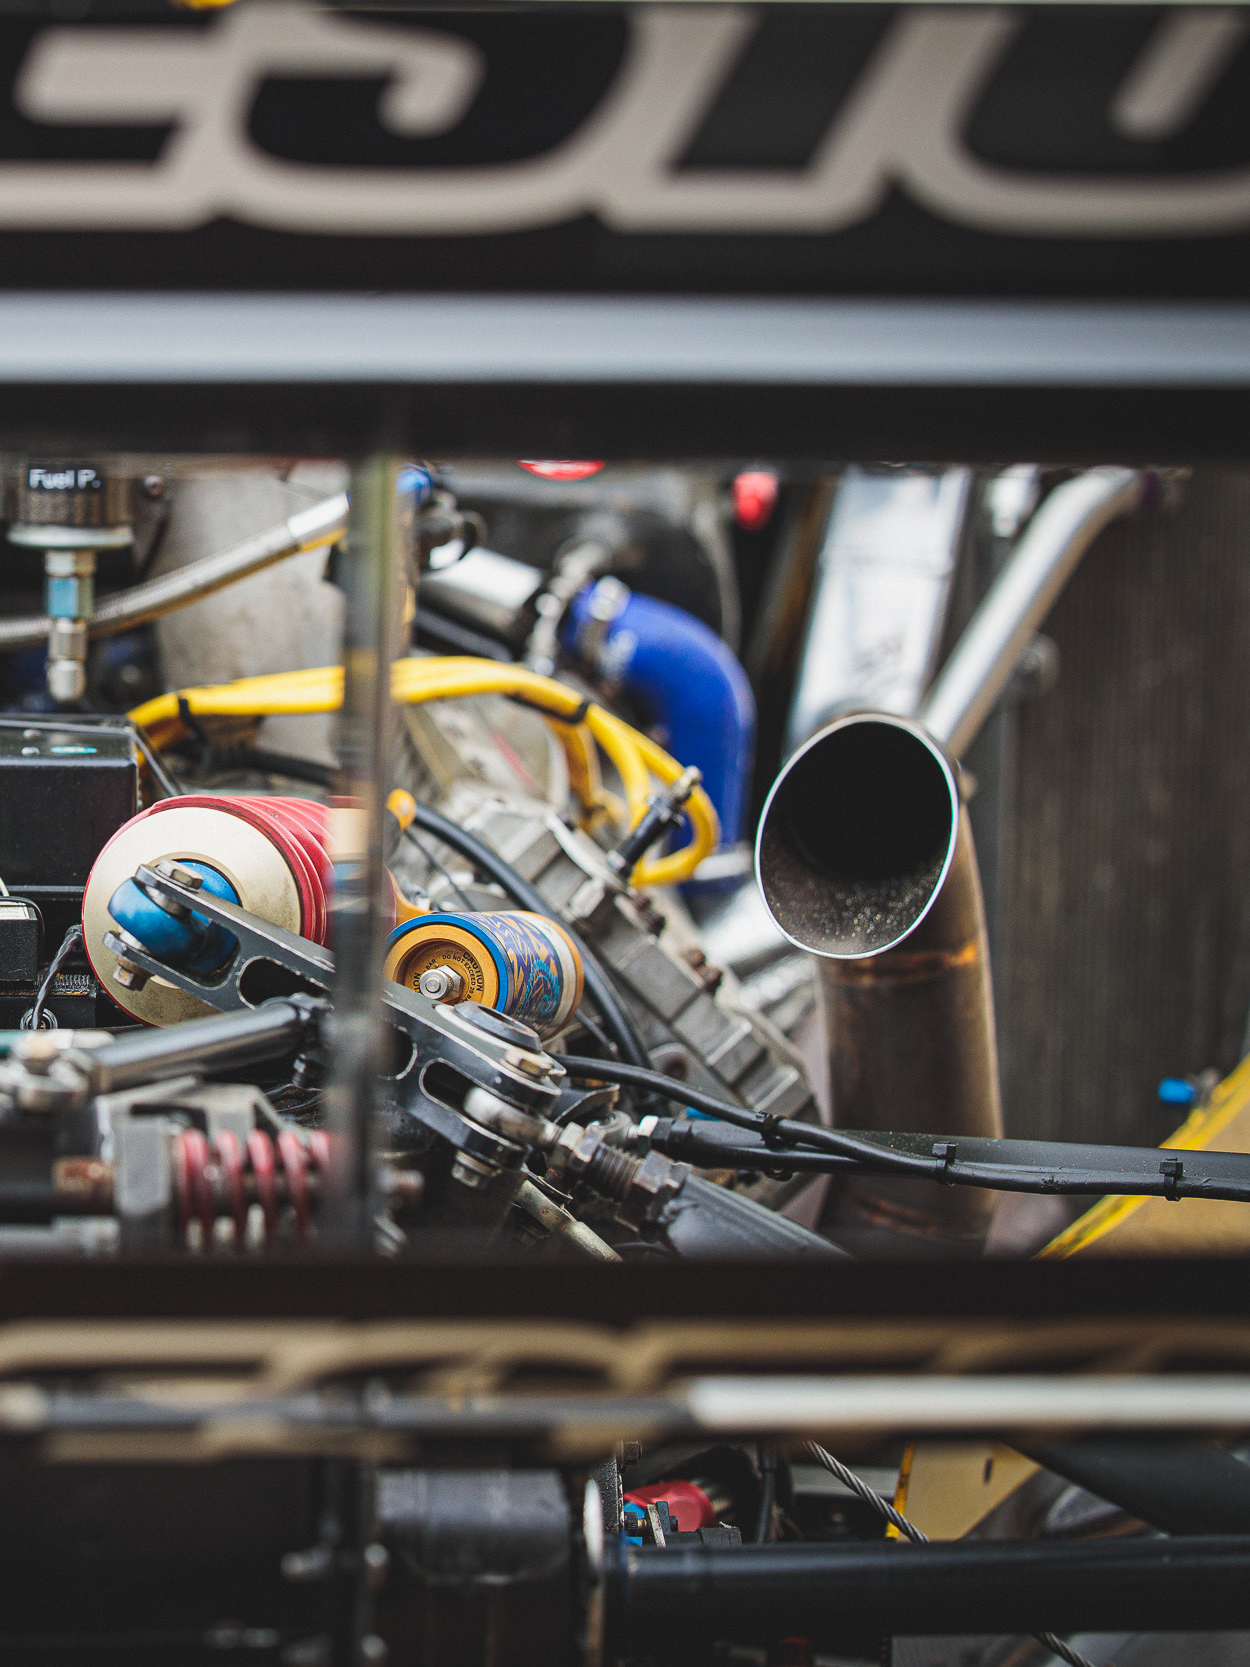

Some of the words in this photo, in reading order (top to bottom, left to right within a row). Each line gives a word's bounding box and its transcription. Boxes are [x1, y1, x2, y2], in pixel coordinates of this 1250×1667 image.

[29, 468, 75, 490] Fuel
[77, 468, 101, 489] P.
[425, 958, 436, 970] BAR
[453, 954, 465, 964] NOT
[464, 962, 476, 986] EXCEED
[463, 952, 483, 992] CAUTION
